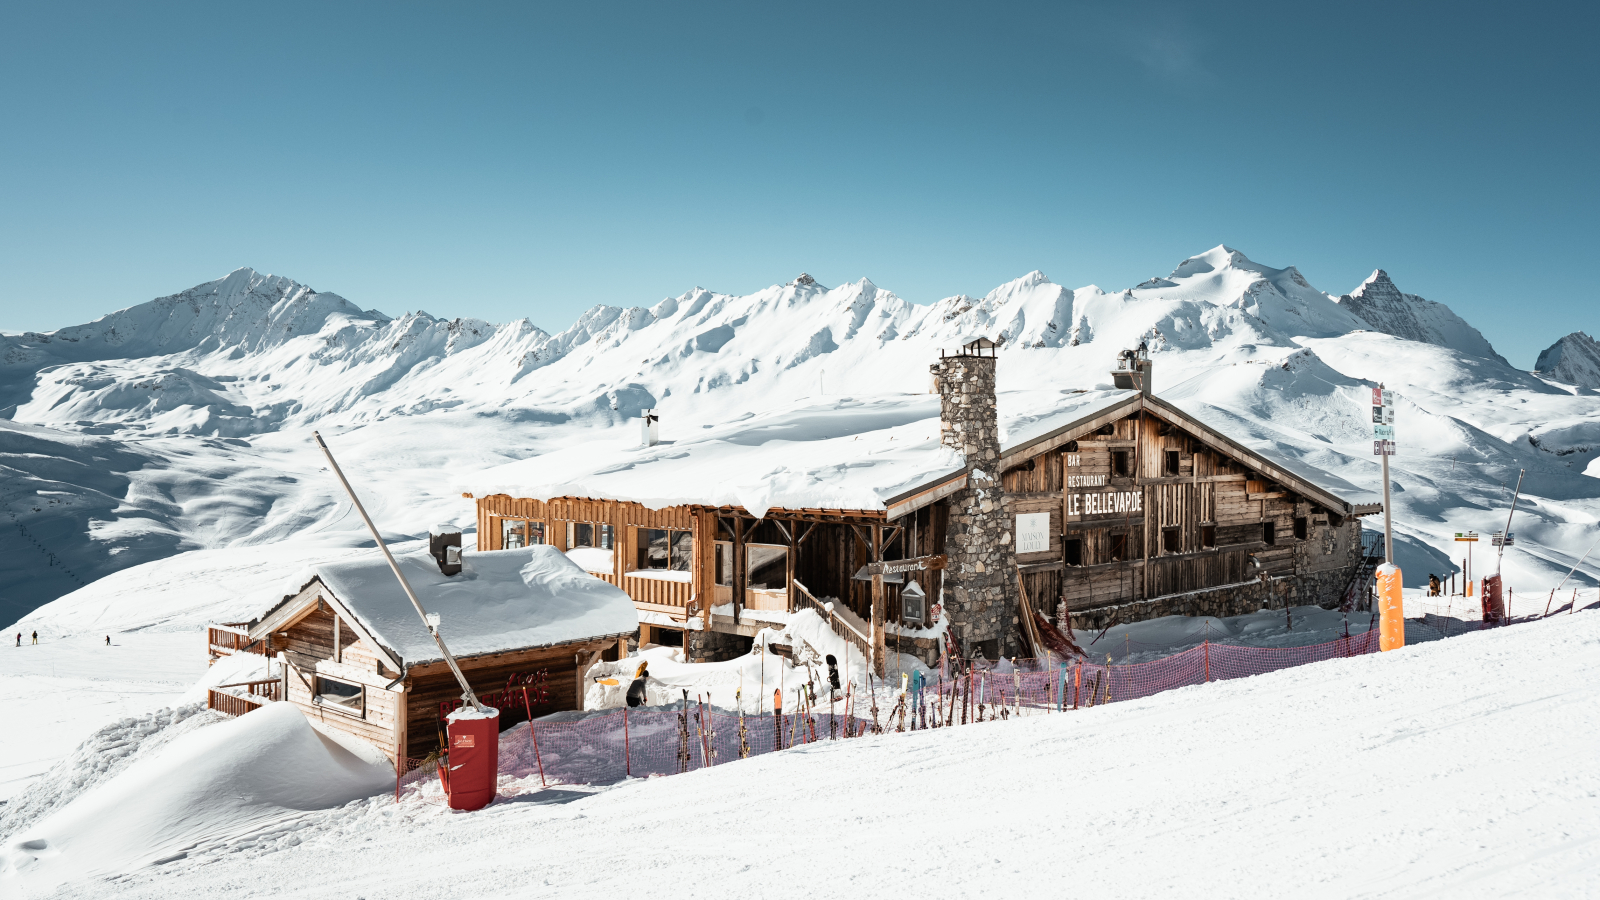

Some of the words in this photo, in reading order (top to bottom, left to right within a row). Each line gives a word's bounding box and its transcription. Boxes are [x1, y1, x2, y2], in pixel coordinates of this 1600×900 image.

[1067, 454, 1080, 467] BAR
[1067, 474, 1105, 488] RESTAURANT
[1067, 493, 1080, 516] LE
[1085, 491, 1142, 515] BELLEVARDE
[883, 561, 928, 575] Restaurant
[517, 667, 550, 689] Café
